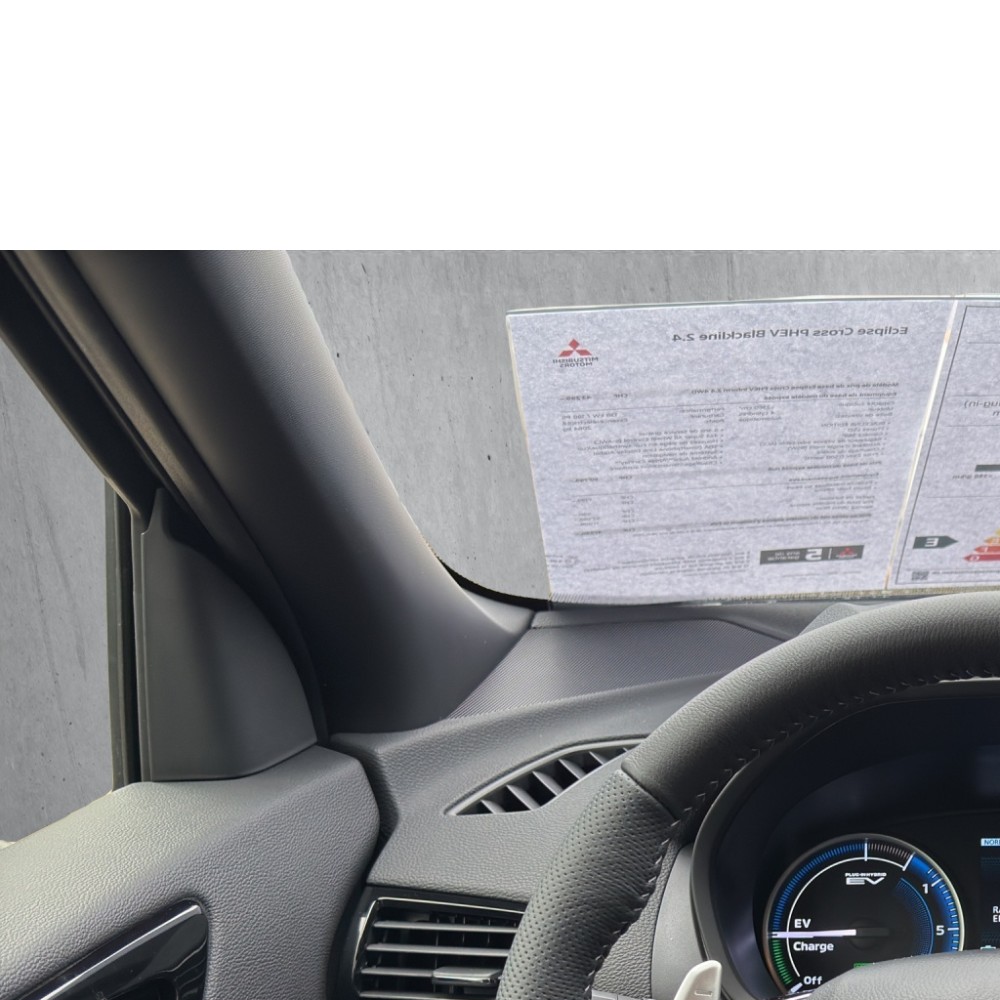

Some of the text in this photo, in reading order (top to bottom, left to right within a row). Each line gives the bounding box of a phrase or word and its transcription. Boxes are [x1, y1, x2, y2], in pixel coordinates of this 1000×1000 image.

[922, 883, 929, 894] 1
[794, 918, 812, 929] EV
[936, 925, 945, 936] 5
[793, 941, 834, 953] Charge
[803, 975, 823, 985] Off
